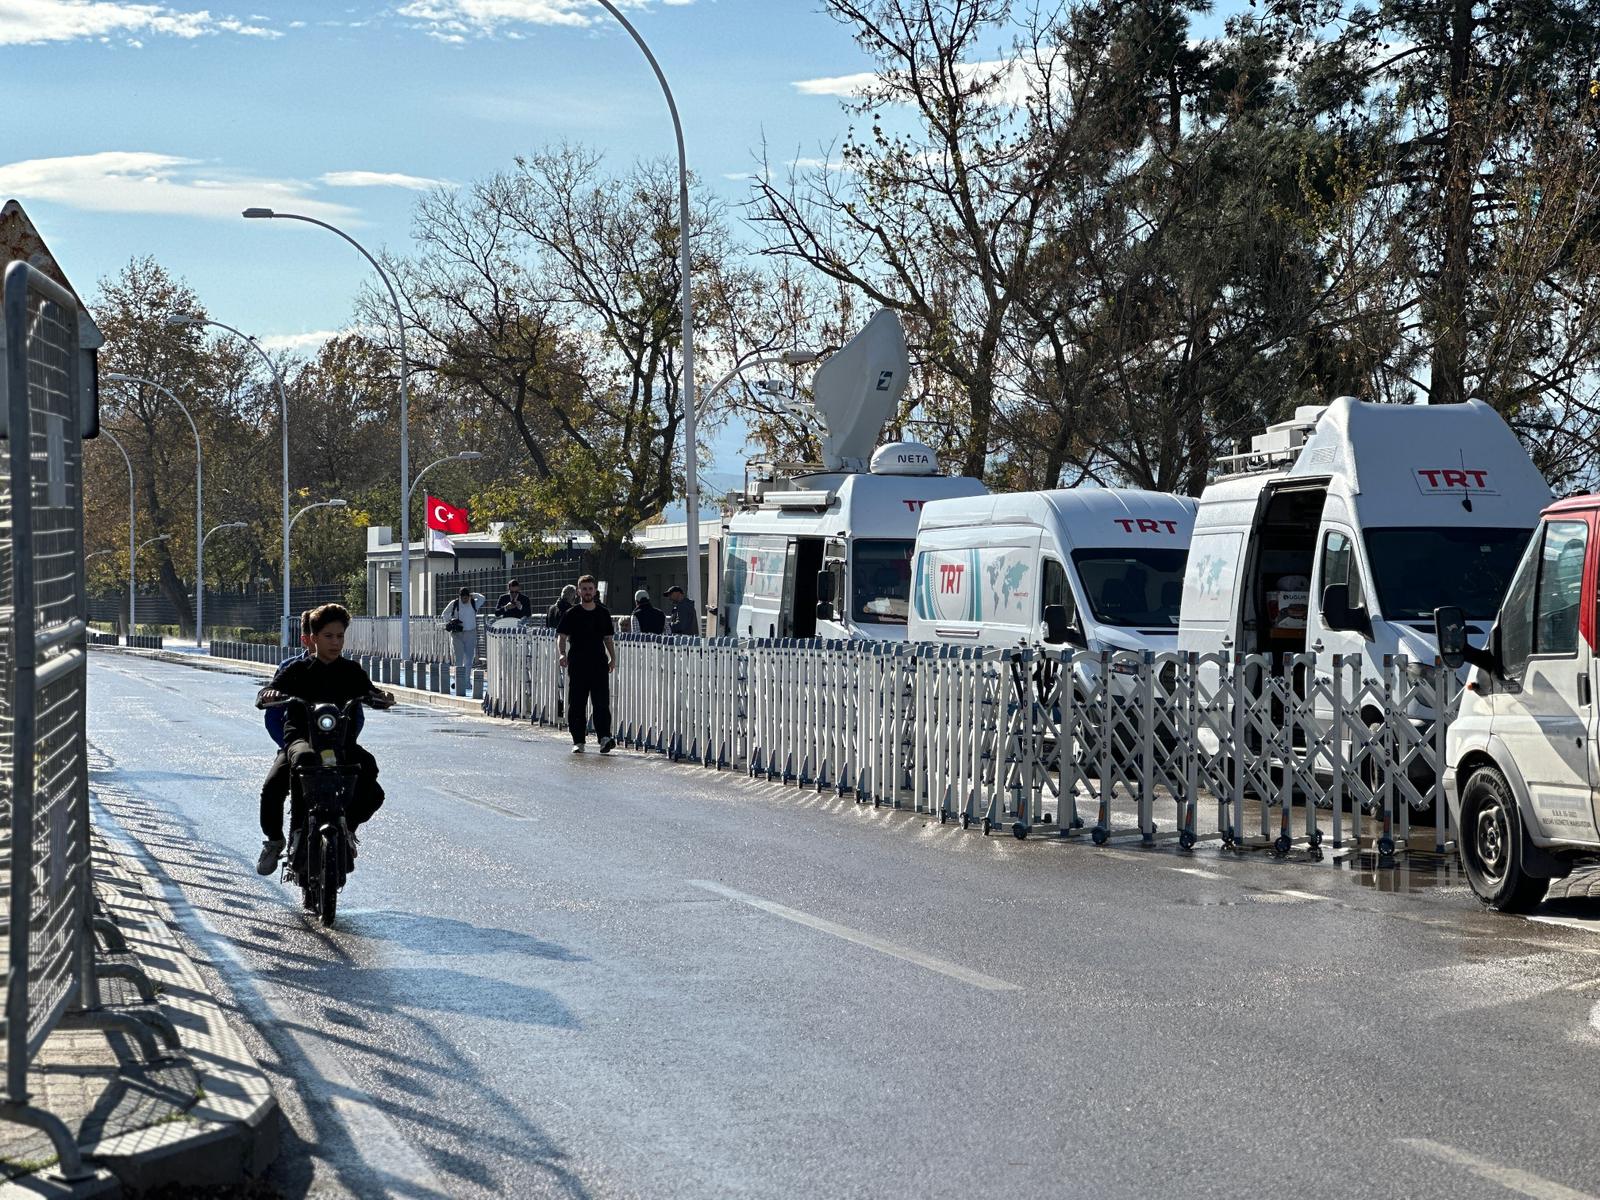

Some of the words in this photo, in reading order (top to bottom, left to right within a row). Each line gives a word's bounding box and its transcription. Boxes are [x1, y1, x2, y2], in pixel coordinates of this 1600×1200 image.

[897, 454, 929, 464] NETA
[1417, 469, 1488, 488] TRT
[1113, 518, 1178, 535] TRT
[940, 564, 965, 595] TRT
